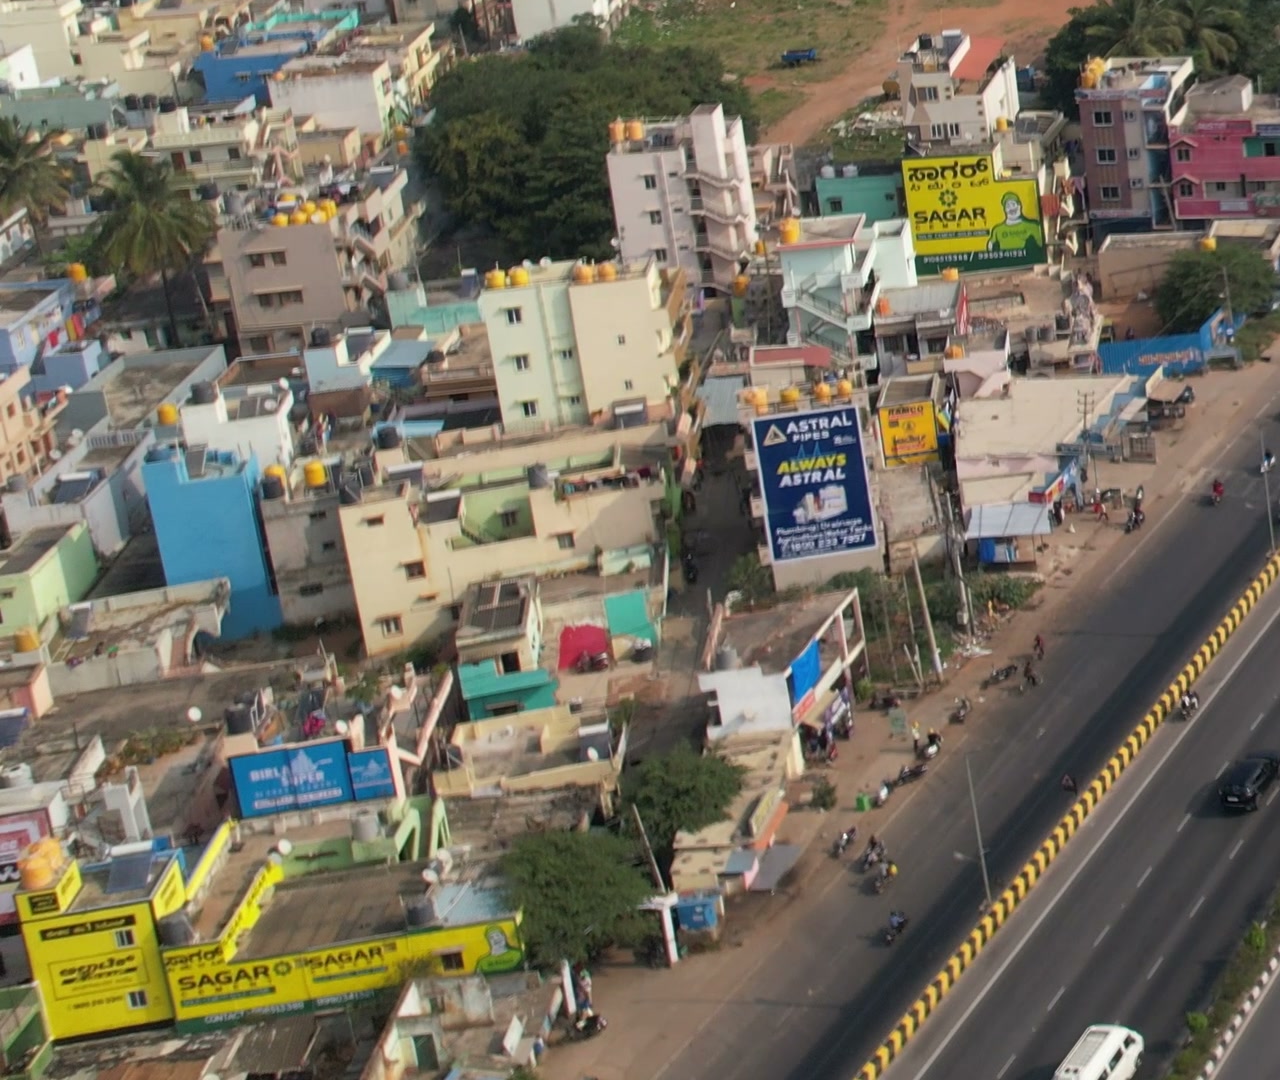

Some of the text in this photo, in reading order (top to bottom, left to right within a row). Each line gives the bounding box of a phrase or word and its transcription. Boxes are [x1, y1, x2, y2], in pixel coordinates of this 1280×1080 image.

[914, 207, 986, 224] SAGAR
[915, 221, 987, 231] CEMENT
[787, 411, 852, 434] ASTRAL
[793, 430, 829, 442] PIPES
[776, 453, 847, 475] ALWAYS
[778, 468, 846, 488] ASTRAL
[307, 943, 383, 969] SAGAR
[178, 965, 270, 990] SAGAR
[204, 1010, 245, 1024] CONTACT
